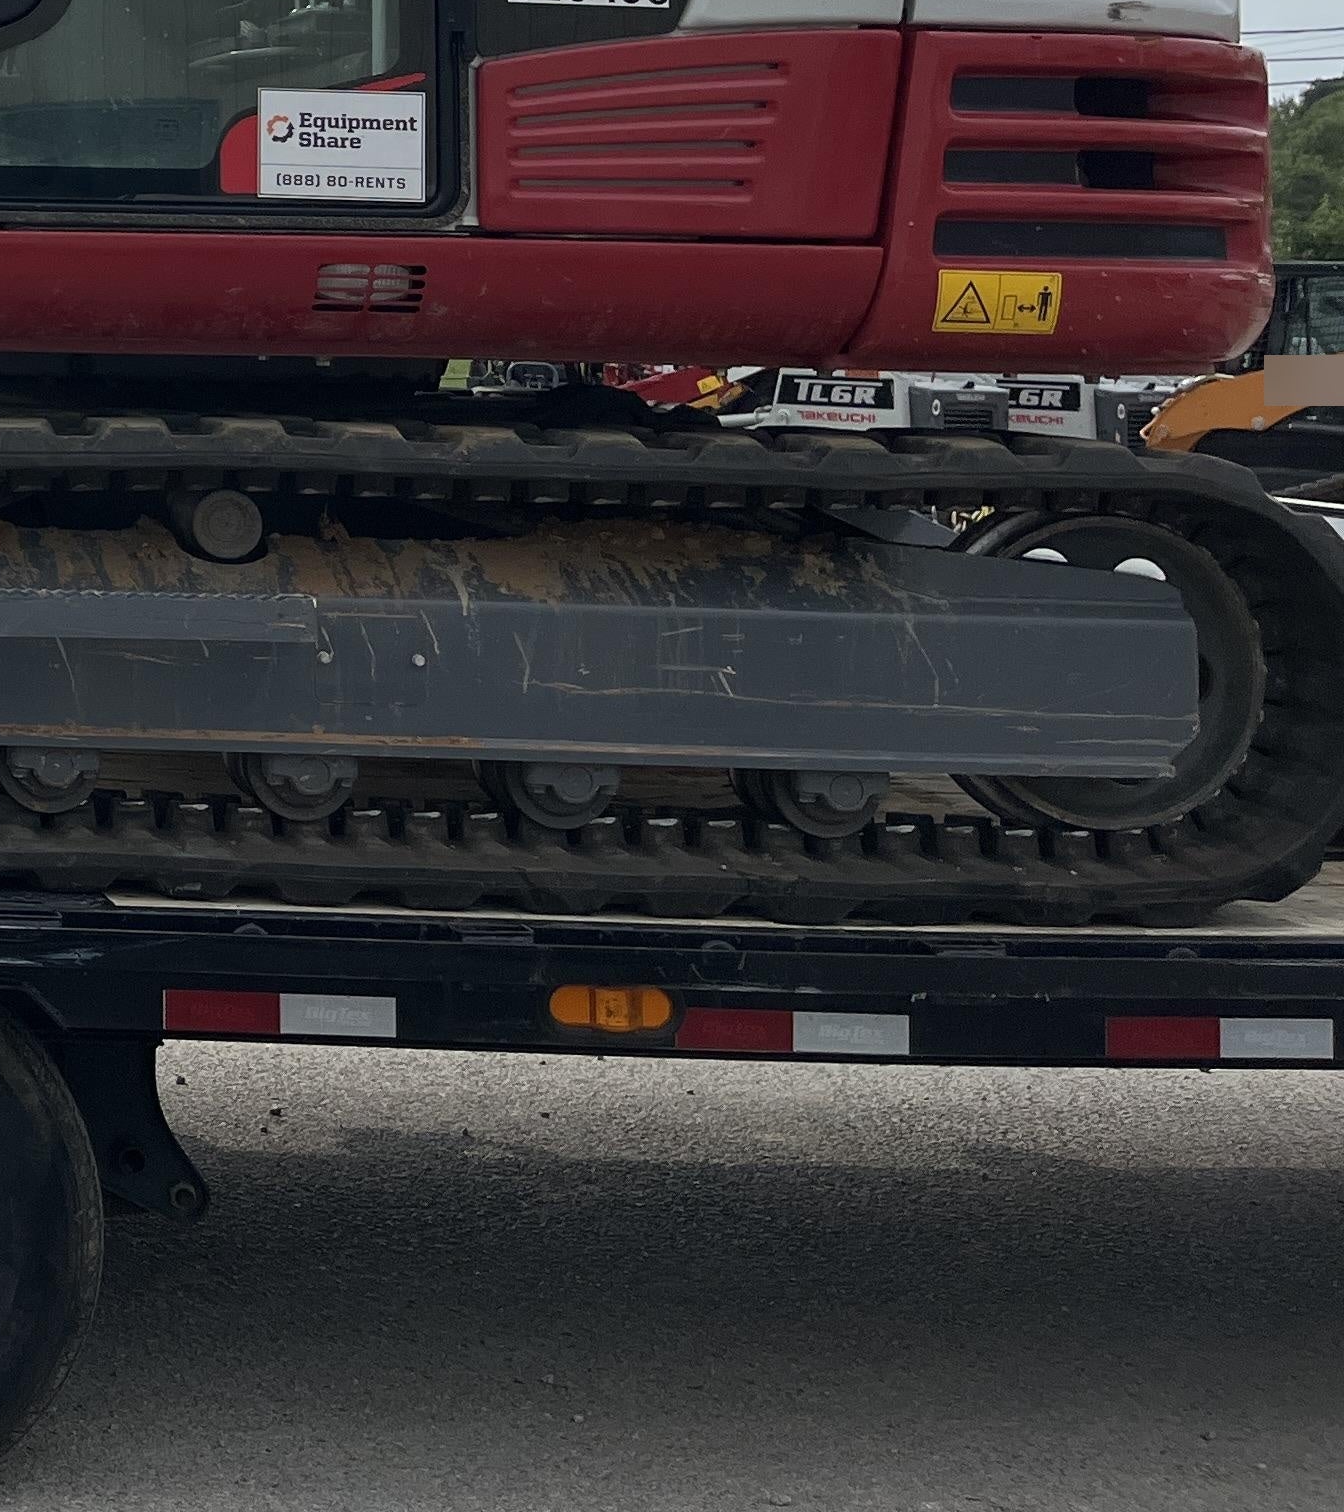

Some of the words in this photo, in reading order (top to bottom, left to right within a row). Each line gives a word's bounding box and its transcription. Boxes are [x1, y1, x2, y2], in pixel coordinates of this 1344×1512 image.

[298, 112, 418, 133] Equipment
[298, 131, 362, 150] Share
[276, 172, 321, 188] (888)
[326, 175, 407, 190] 80-RENTS
[793, 378, 883, 405] TL6R
